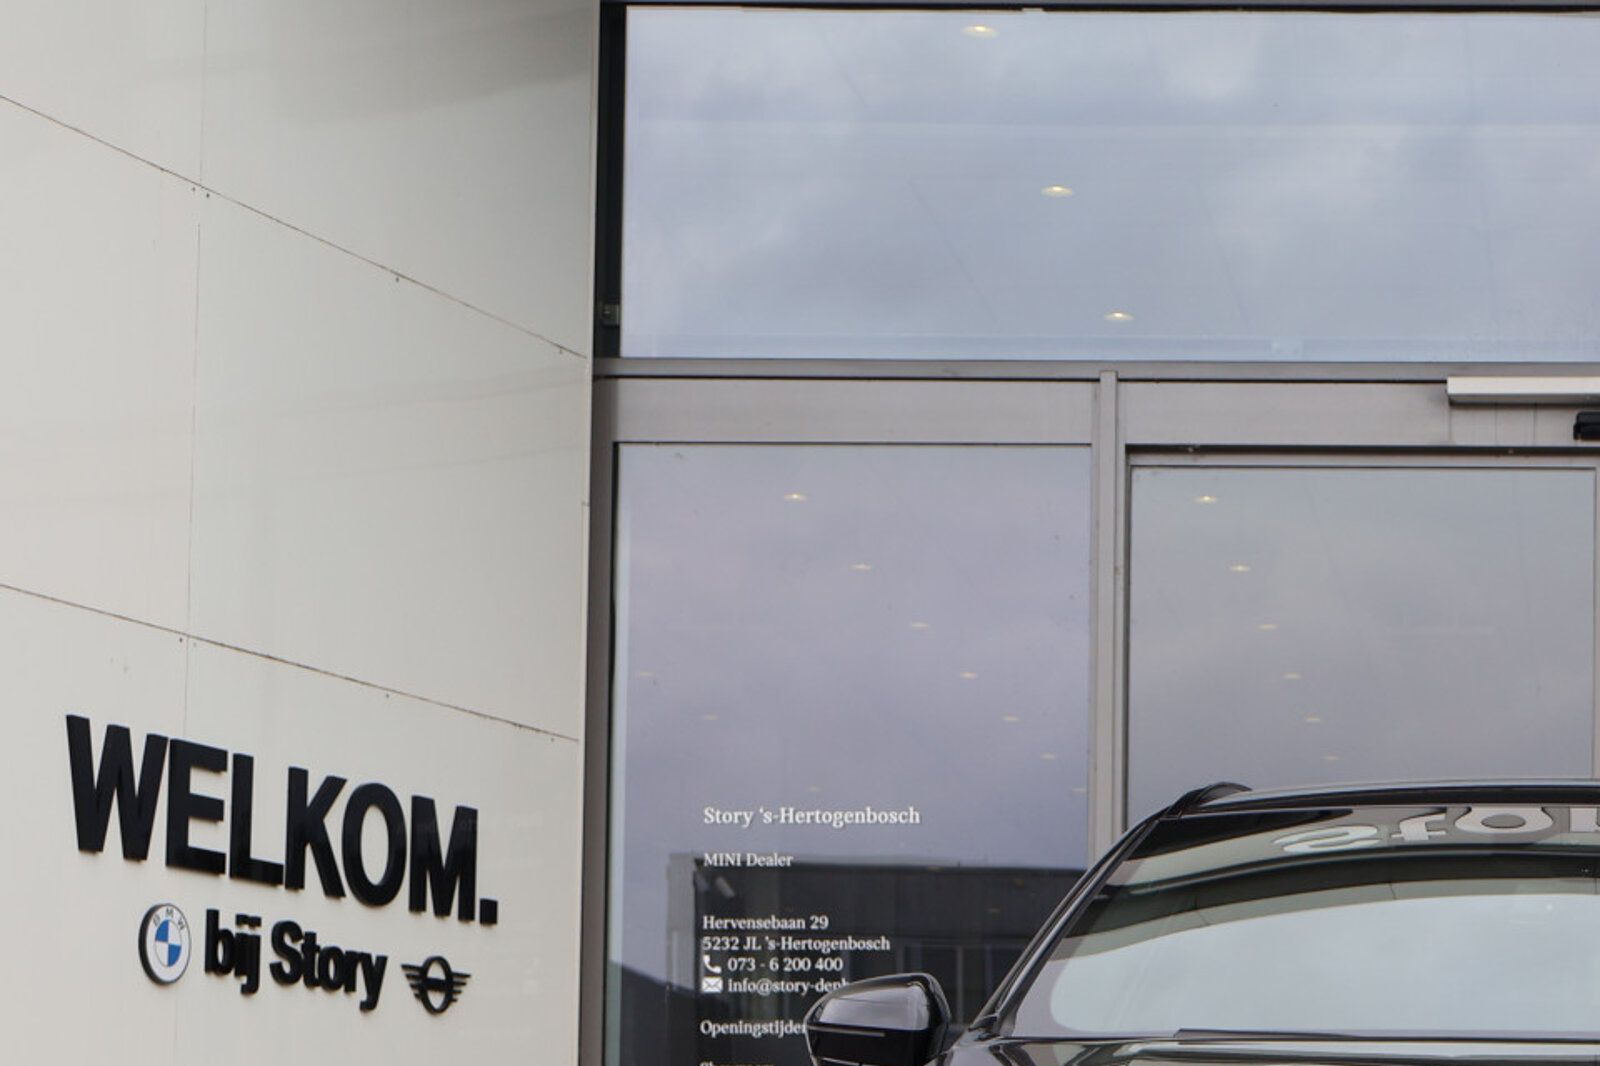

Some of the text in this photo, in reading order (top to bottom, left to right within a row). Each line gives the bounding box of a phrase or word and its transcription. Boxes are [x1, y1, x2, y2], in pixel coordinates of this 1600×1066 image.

[66, 714, 498, 925] WELKOM.
[704, 807, 753, 828] Story
[704, 853, 793, 867] MINI Dealer
[703, 915, 829, 930] Hervensebaan 29
[702, 936, 891, 954] 5232 JL 's-Hertogenbosch
[205, 908, 388, 1011] bij Story
[728, 958, 756, 972] 073
[769, 958, 779, 972] 6
[783, 958, 811, 972] 200
[815, 958, 843, 972] 400
